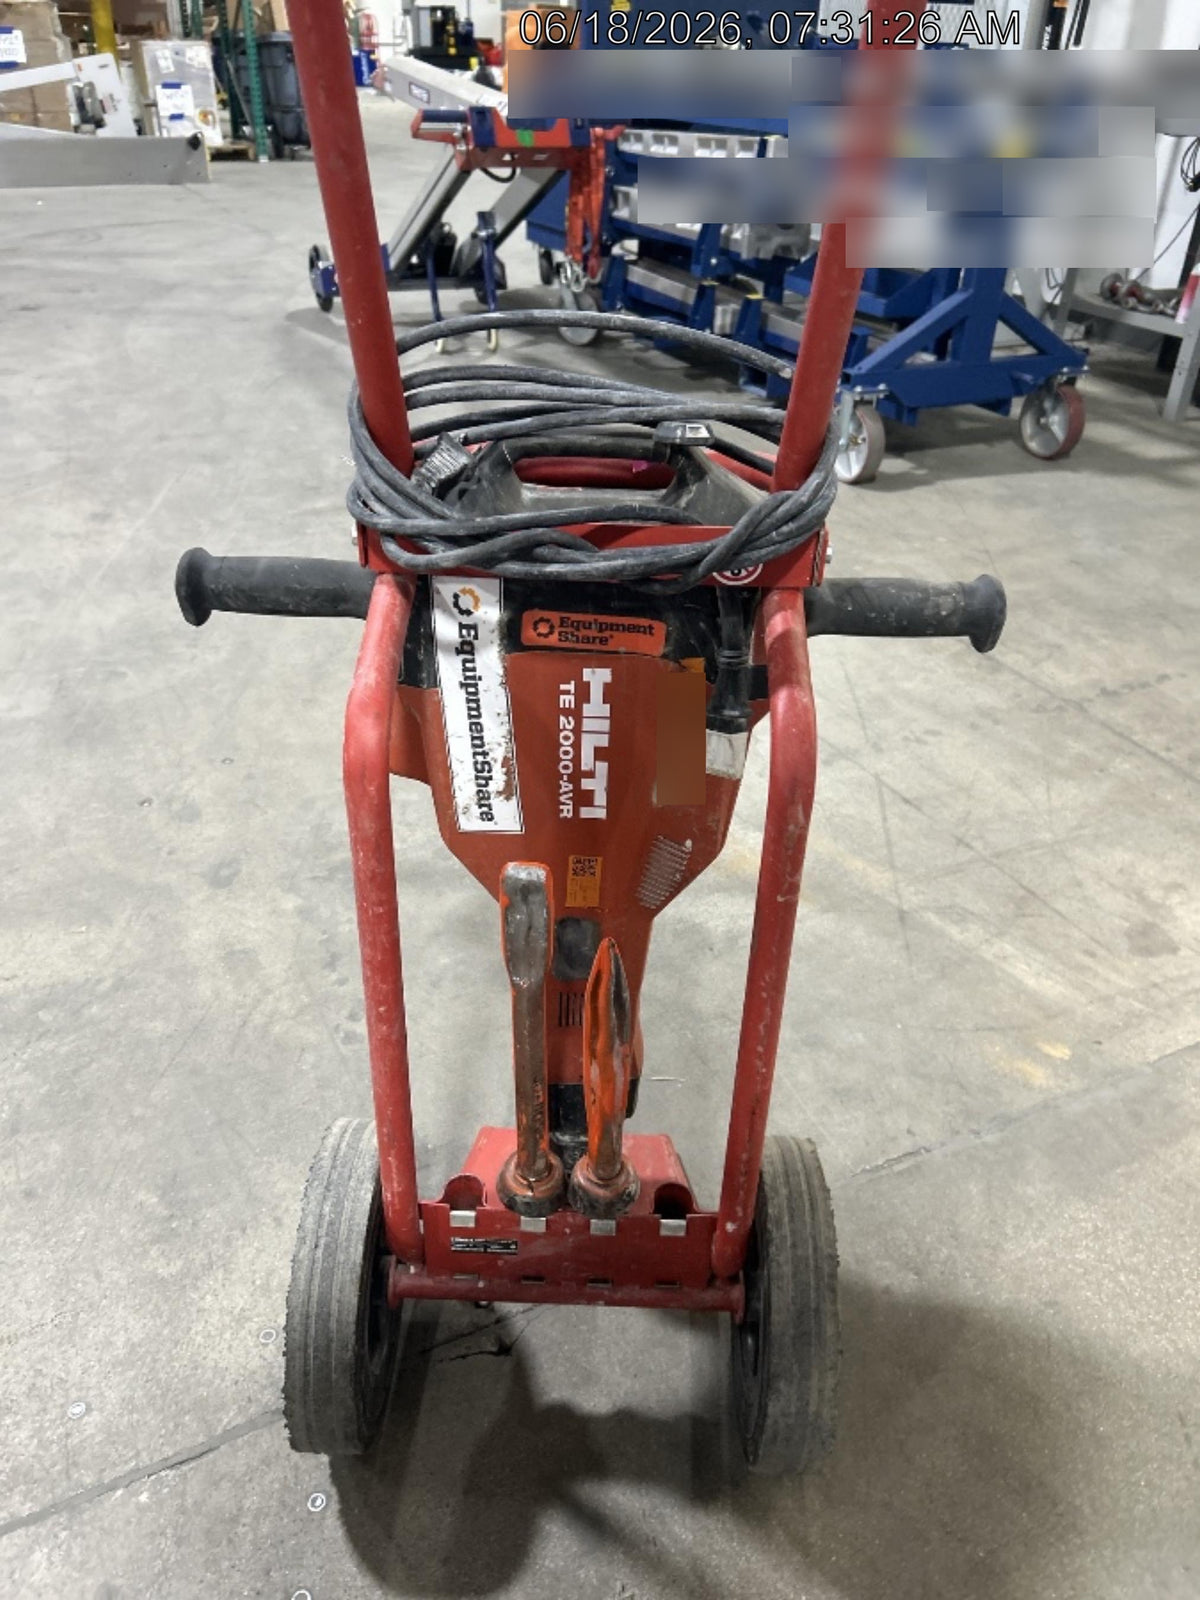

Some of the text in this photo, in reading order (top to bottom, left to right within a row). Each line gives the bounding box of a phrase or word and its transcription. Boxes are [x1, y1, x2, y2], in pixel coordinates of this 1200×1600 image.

[558, 616, 656, 636] Equipment
[455, 621, 495, 823] EquipmentShare
[558, 680, 576, 819] TE 2000-AVR
[579, 667, 613, 820] HILTI
